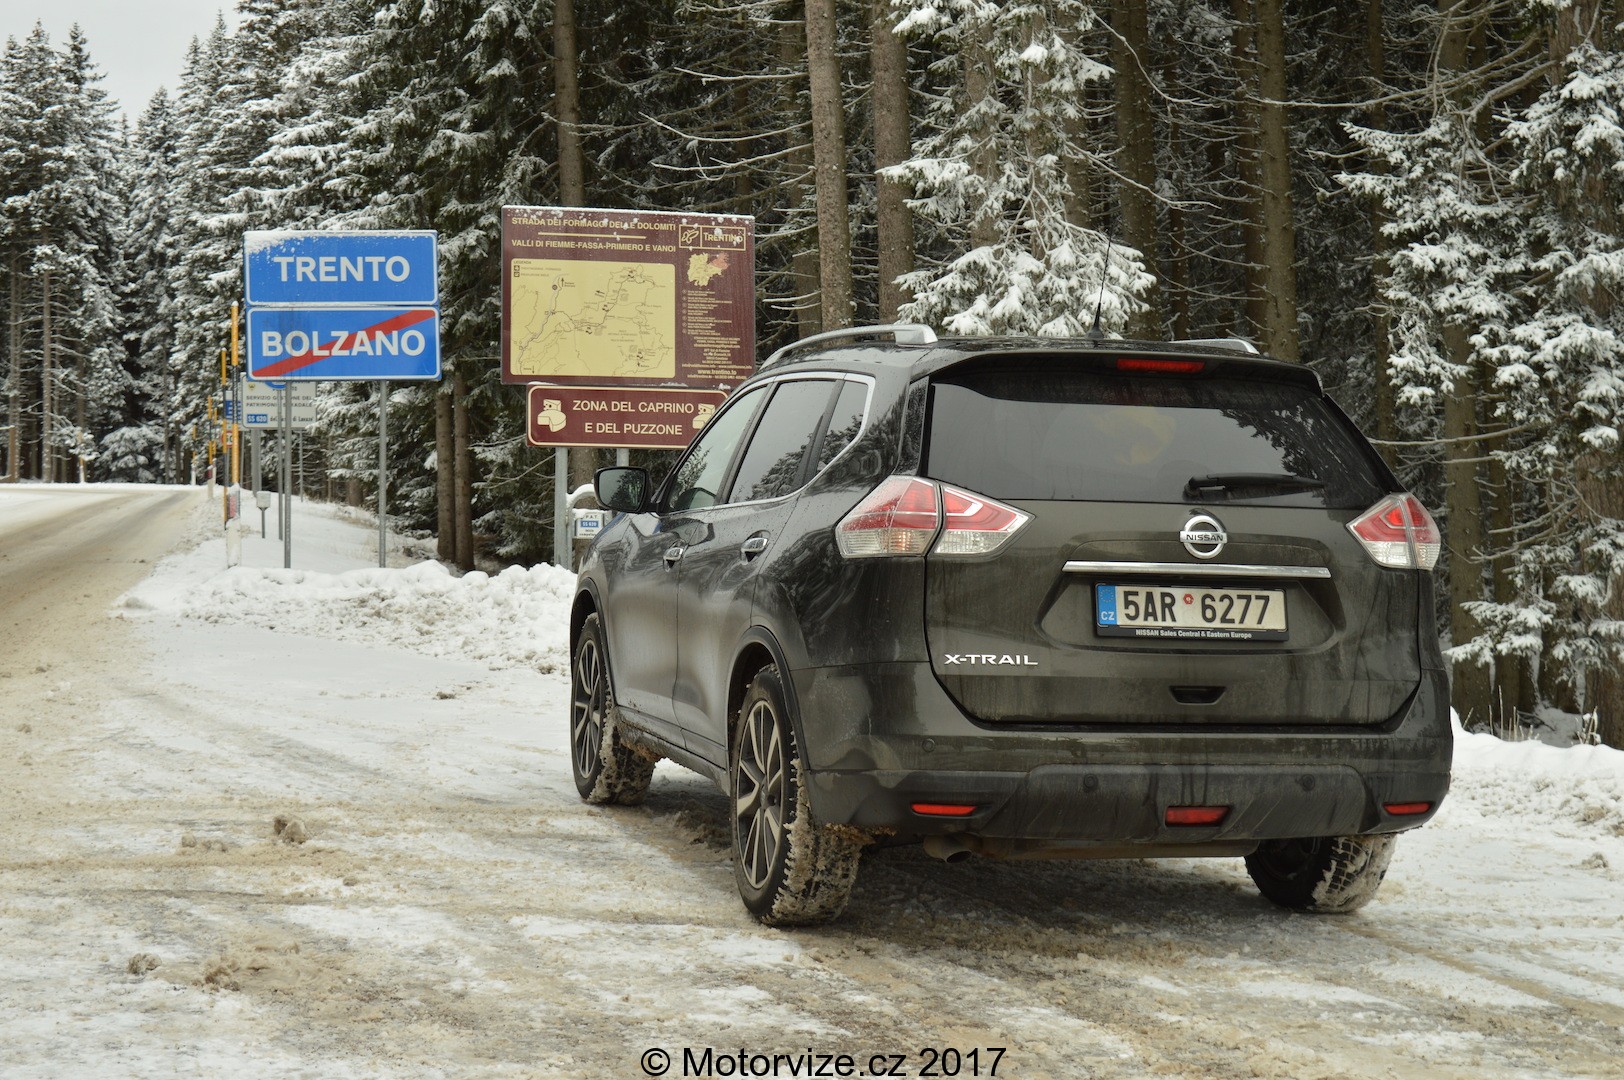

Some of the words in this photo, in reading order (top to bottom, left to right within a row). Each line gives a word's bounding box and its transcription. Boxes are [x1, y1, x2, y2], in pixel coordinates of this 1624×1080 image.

[511, 217, 546, 226] STRADA
[548, 218, 561, 226] DEI
[638, 221, 676, 231] DOLOMITI
[511, 239, 534, 247] VALLI
[536, 240, 544, 248] DI
[545, 240, 644, 251] FIEMME-FASSA-PRIMIERO
[652, 244, 676, 252] VANOI
[272, 255, 411, 283] TRENTO
[261, 329, 426, 357] BOLZANO
[572, 400, 608, 412] ZONA
[611, 401, 634, 413] DEL
[638, 402, 694, 414] CAPRINO
[584, 422, 593, 433] E
[596, 422, 620, 434] DEL
[623, 423, 683, 436] PUZZONE
[1186, 534, 1224, 542] NISSAN
[1122, 590, 1177, 623] 5AR
[1200, 593, 1271, 625] 6277
[1100, 611, 1115, 621] CZ
[1135, 628, 1159, 636] NISSAN
[1159, 629, 1177, 637] Sales
[1177, 630, 1200, 638] Central
[1206, 630, 1230, 639] Eastern
[1230, 631, 1252, 640] Europe
[943, 653, 1039, 666] X-TRAIL
